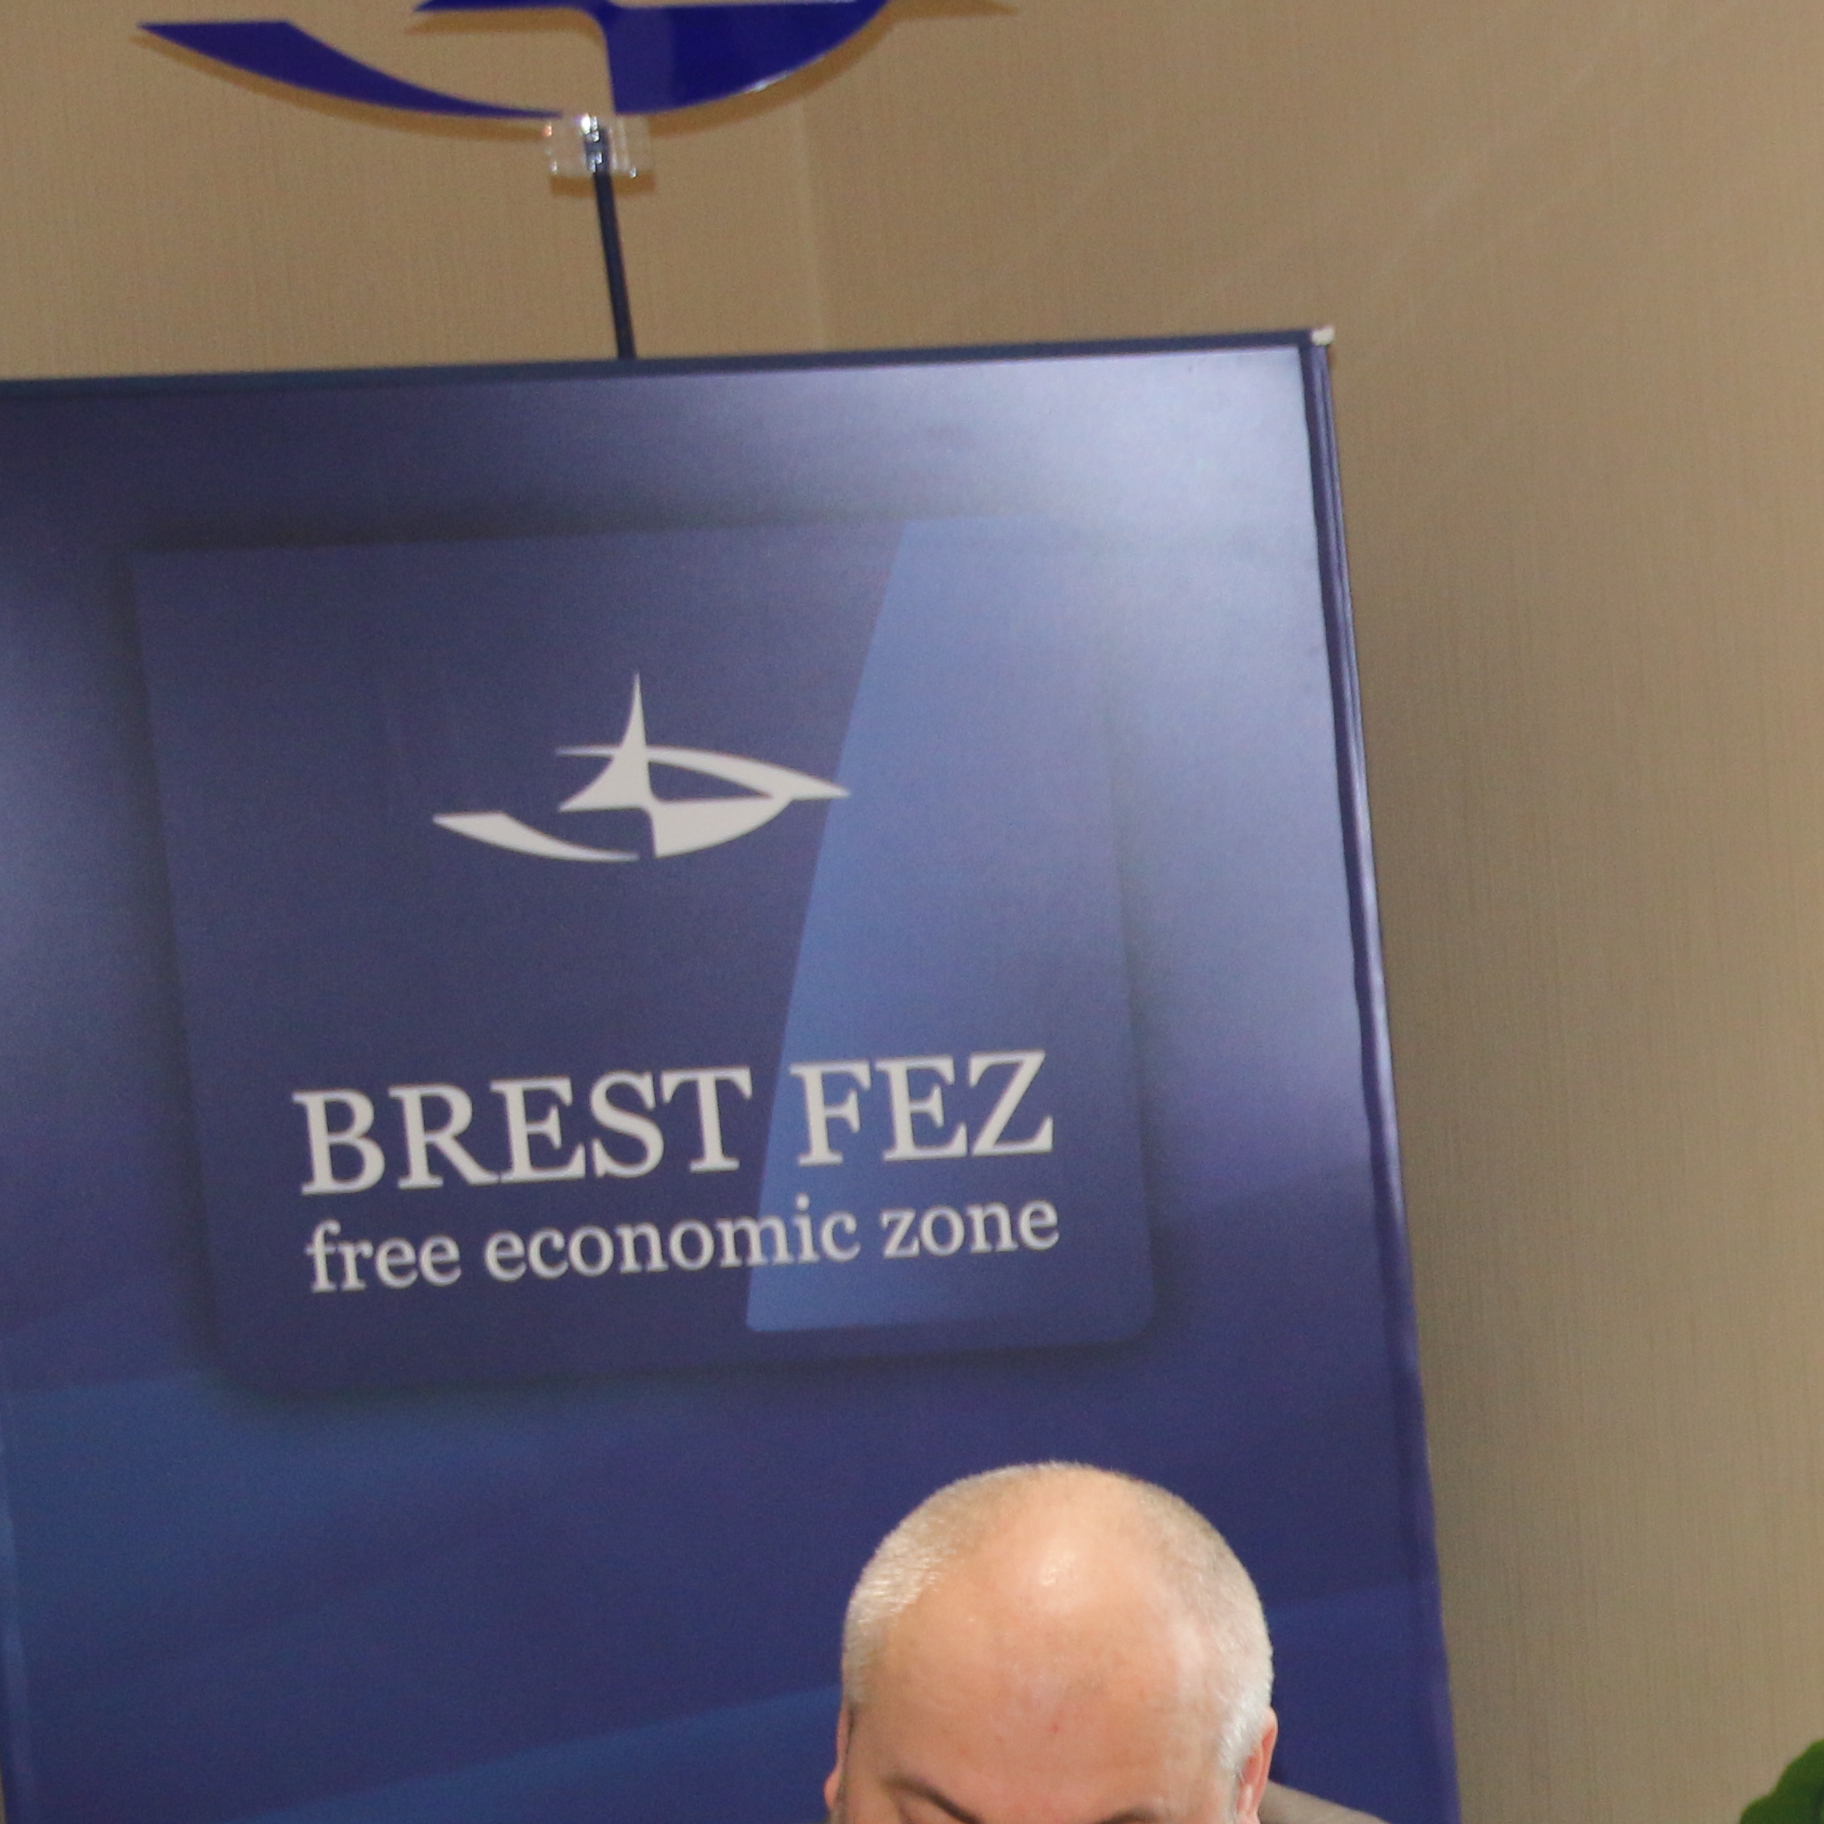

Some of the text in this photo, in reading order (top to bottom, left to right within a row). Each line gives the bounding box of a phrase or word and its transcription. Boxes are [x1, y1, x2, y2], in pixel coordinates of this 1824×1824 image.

[293, 1050, 1053, 1195] BREST FEZ
[305, 1195, 1060, 1293] free economic zone
